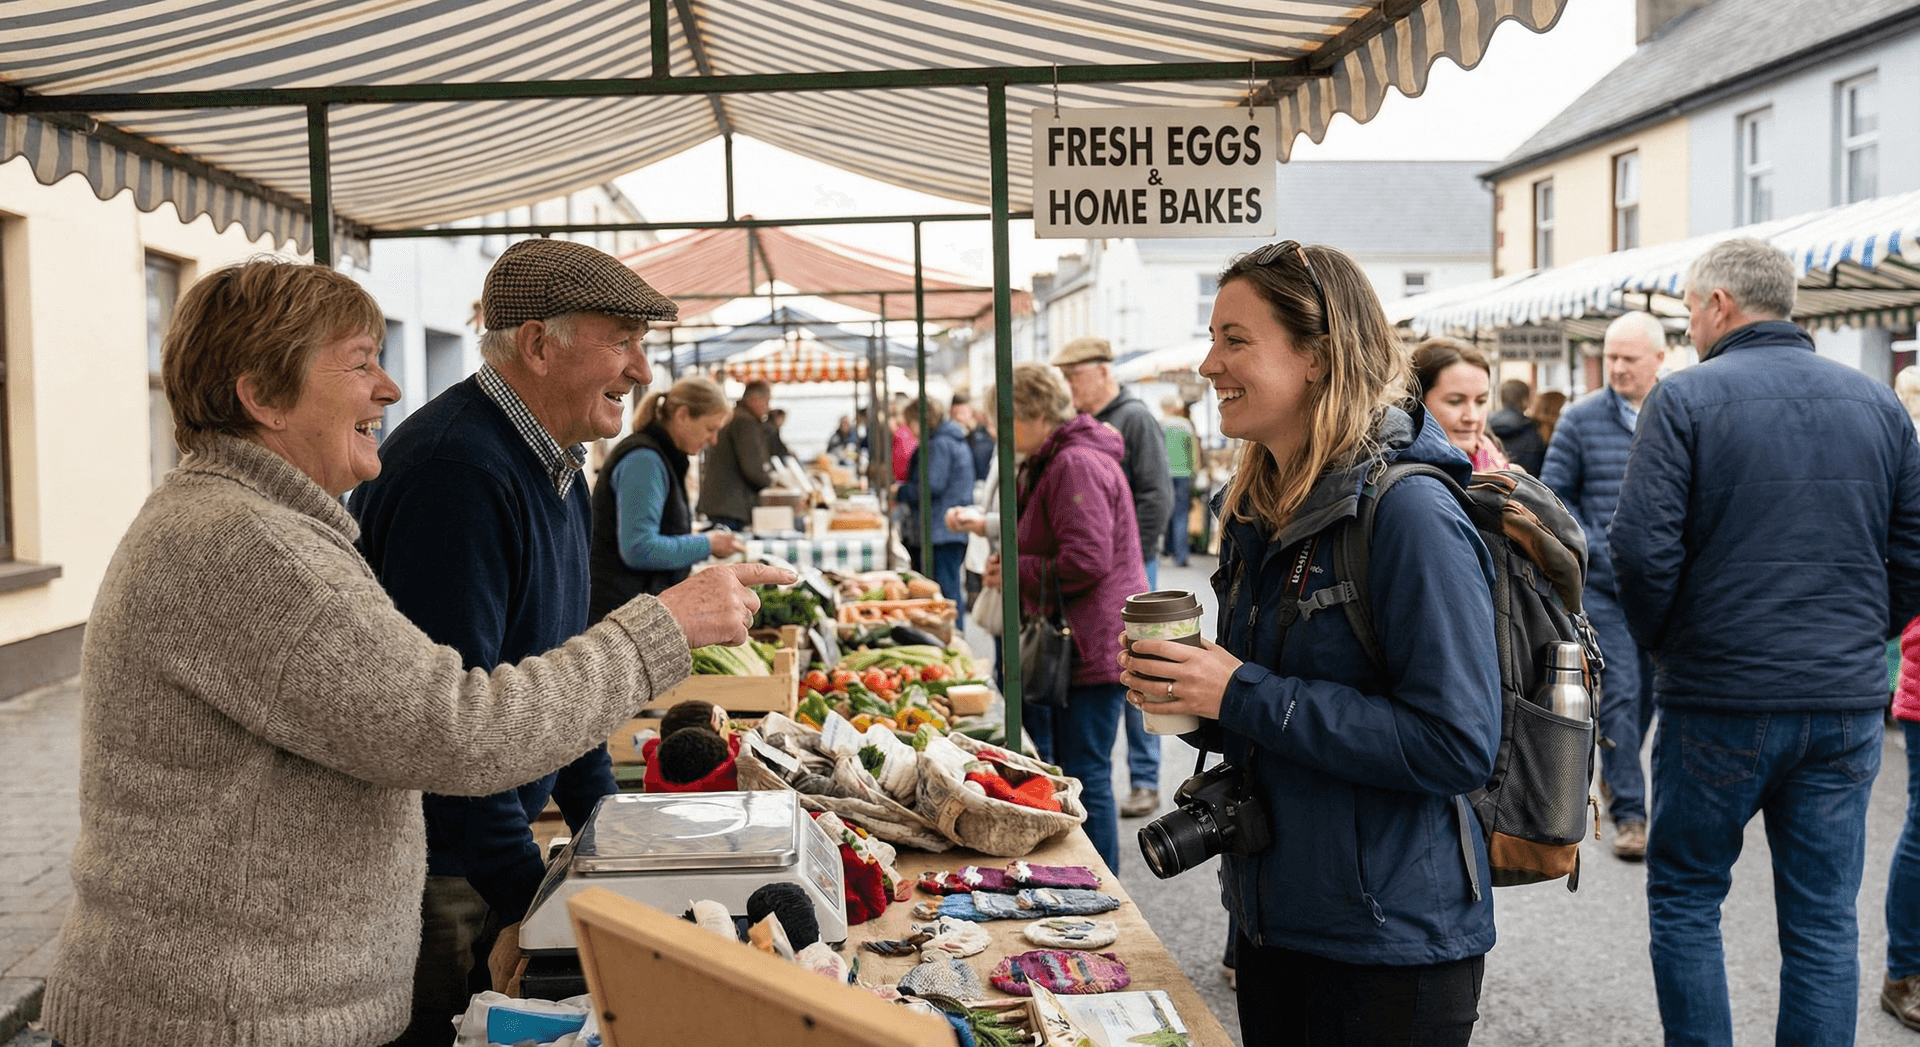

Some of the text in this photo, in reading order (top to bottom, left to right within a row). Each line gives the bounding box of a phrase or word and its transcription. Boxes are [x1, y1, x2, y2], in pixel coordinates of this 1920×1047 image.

[1048, 125, 1261, 166] FRESH EGGS
[1147, 169, 1163, 186] &
[1050, 188, 1262, 225] HOME BAKES
